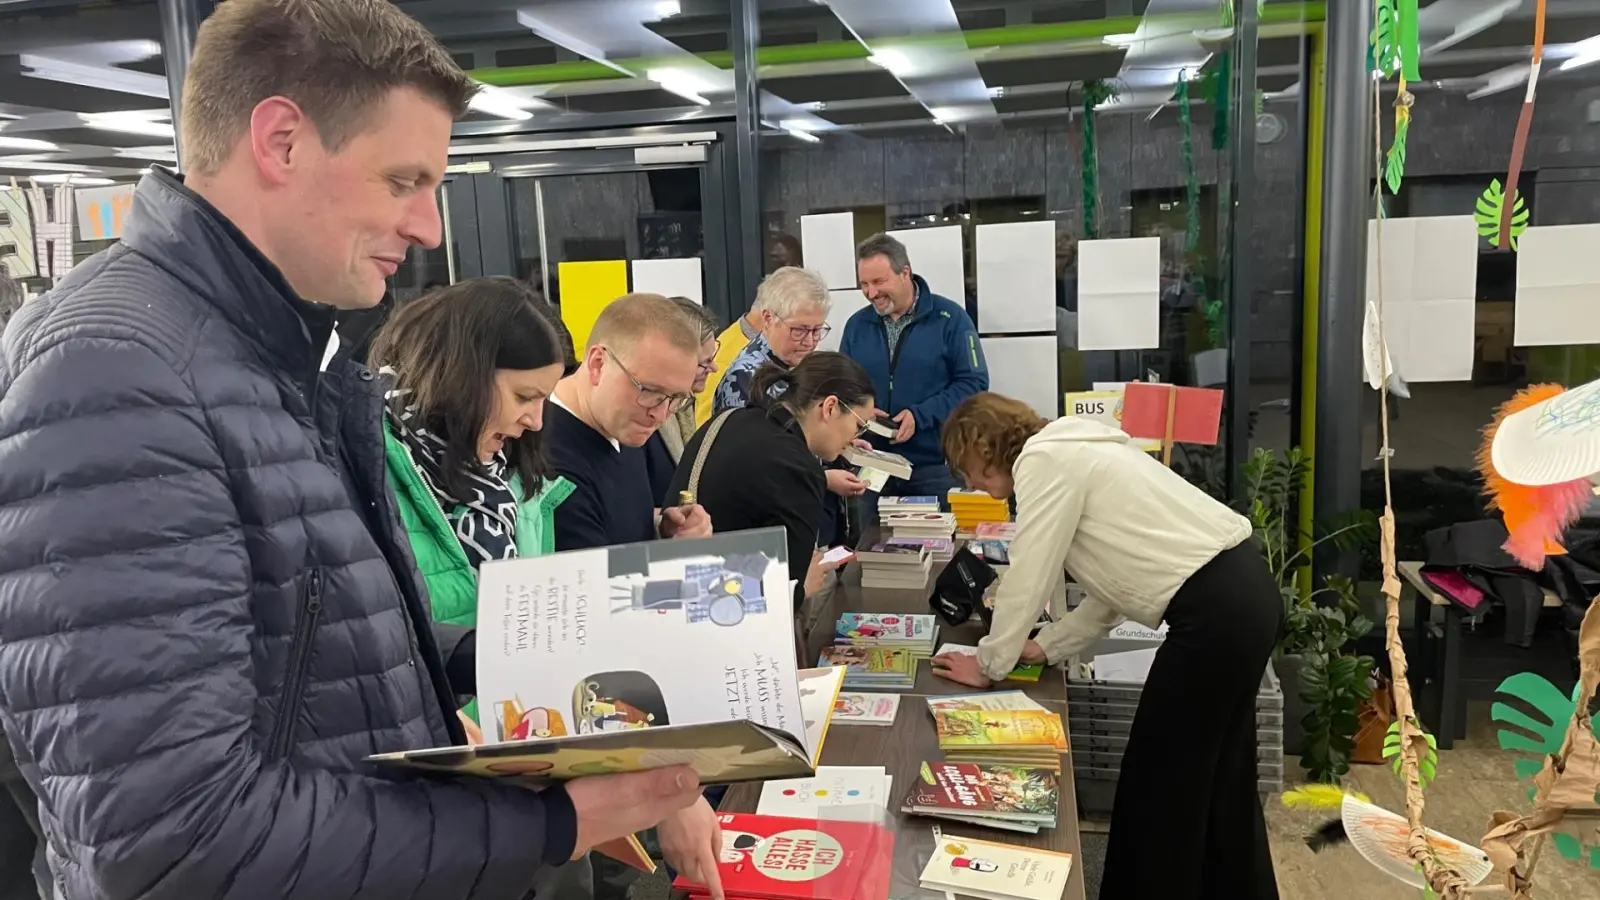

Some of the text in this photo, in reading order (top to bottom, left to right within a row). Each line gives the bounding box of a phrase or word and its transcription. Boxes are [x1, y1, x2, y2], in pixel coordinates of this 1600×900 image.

[1075, 402, 1105, 415] BUS
[546, 586, 559, 622] BESTIE
[725, 665, 741, 704] JETZT
[742, 682, 752, 704] werde
[754, 668, 771, 702] MUSS
[757, 836, 793, 870] ALLES!
[785, 839, 817, 871] HASSE
[812, 847, 838, 865] ICH
